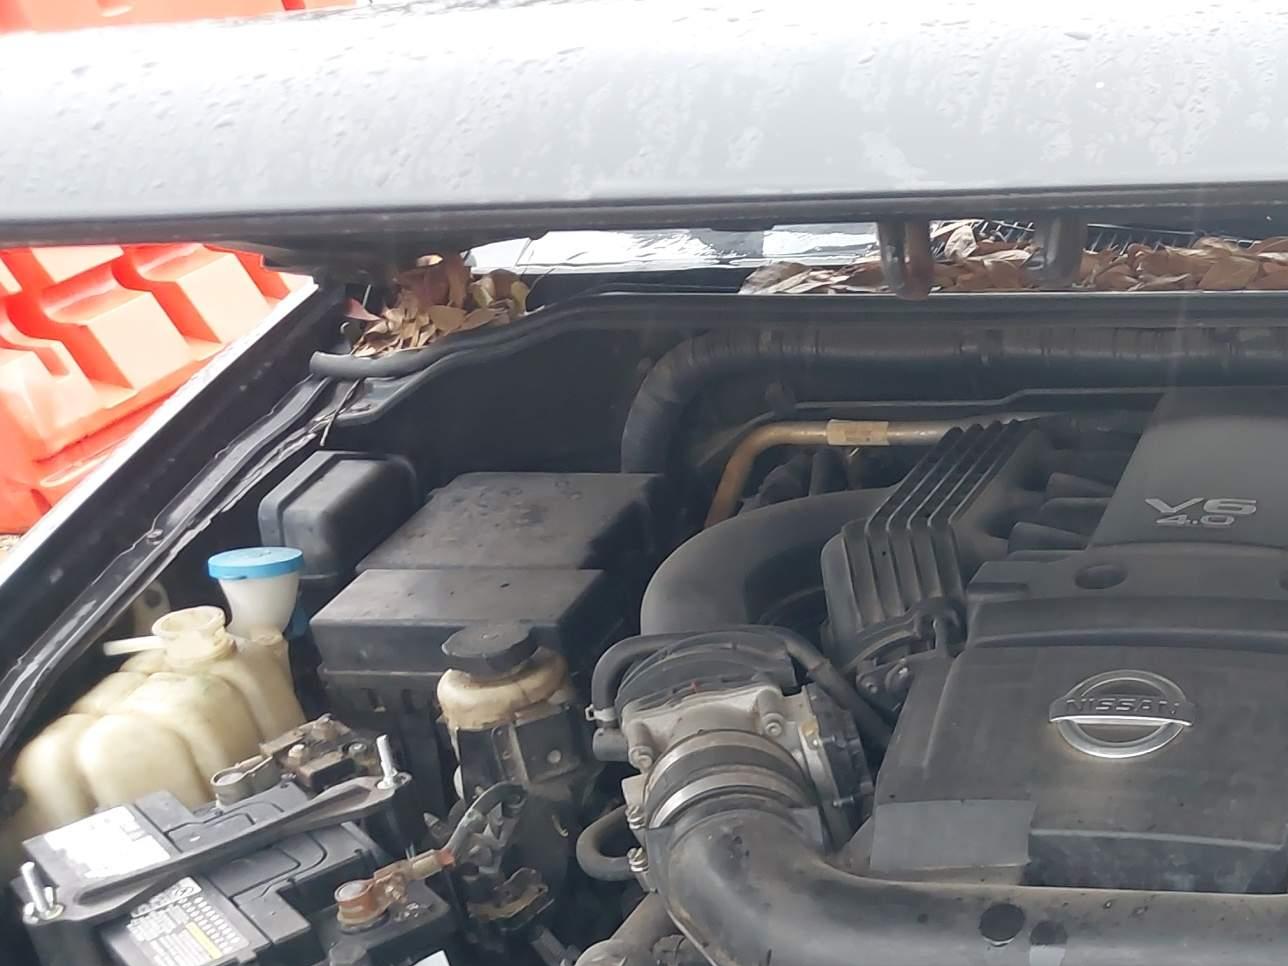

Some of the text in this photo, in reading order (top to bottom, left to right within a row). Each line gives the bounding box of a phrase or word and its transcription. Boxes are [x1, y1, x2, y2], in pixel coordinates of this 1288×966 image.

[1144, 497, 1257, 515] V6
[1155, 513, 1235, 526] 4.0
[1065, 697, 1181, 716] NISSAN
